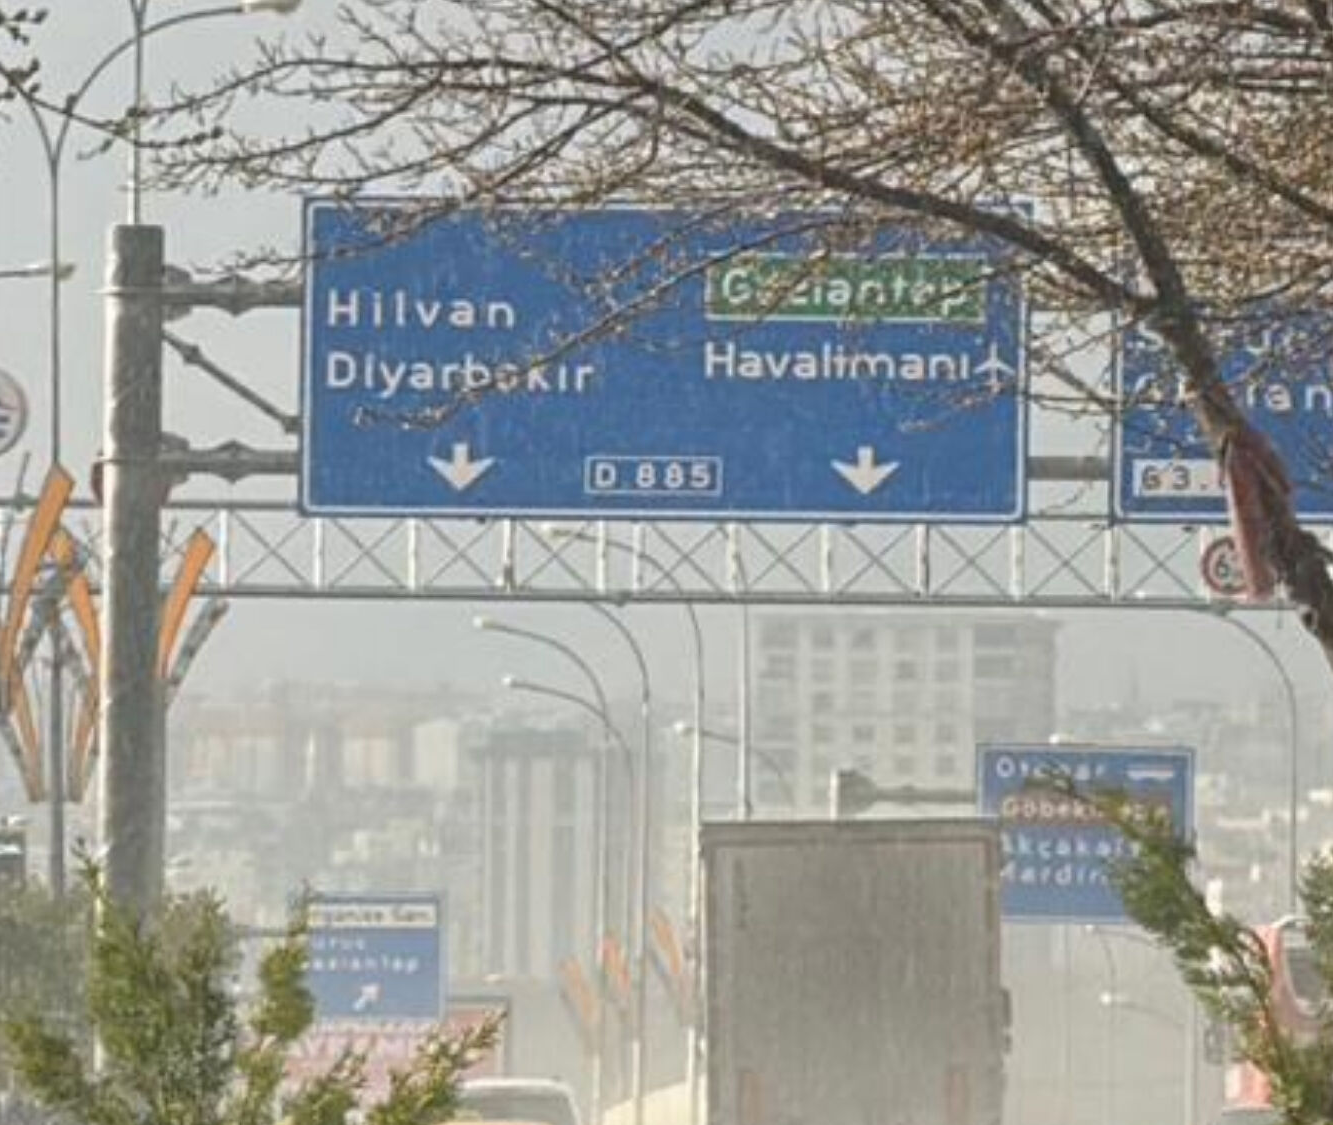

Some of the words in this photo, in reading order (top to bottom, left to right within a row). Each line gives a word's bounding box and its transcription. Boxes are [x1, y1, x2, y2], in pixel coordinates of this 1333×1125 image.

[327, 288, 516, 329] Hilvan
[704, 341, 970, 380] Havalimanı
[595, 461, 617, 489] D
[636, 461, 711, 489] 885
